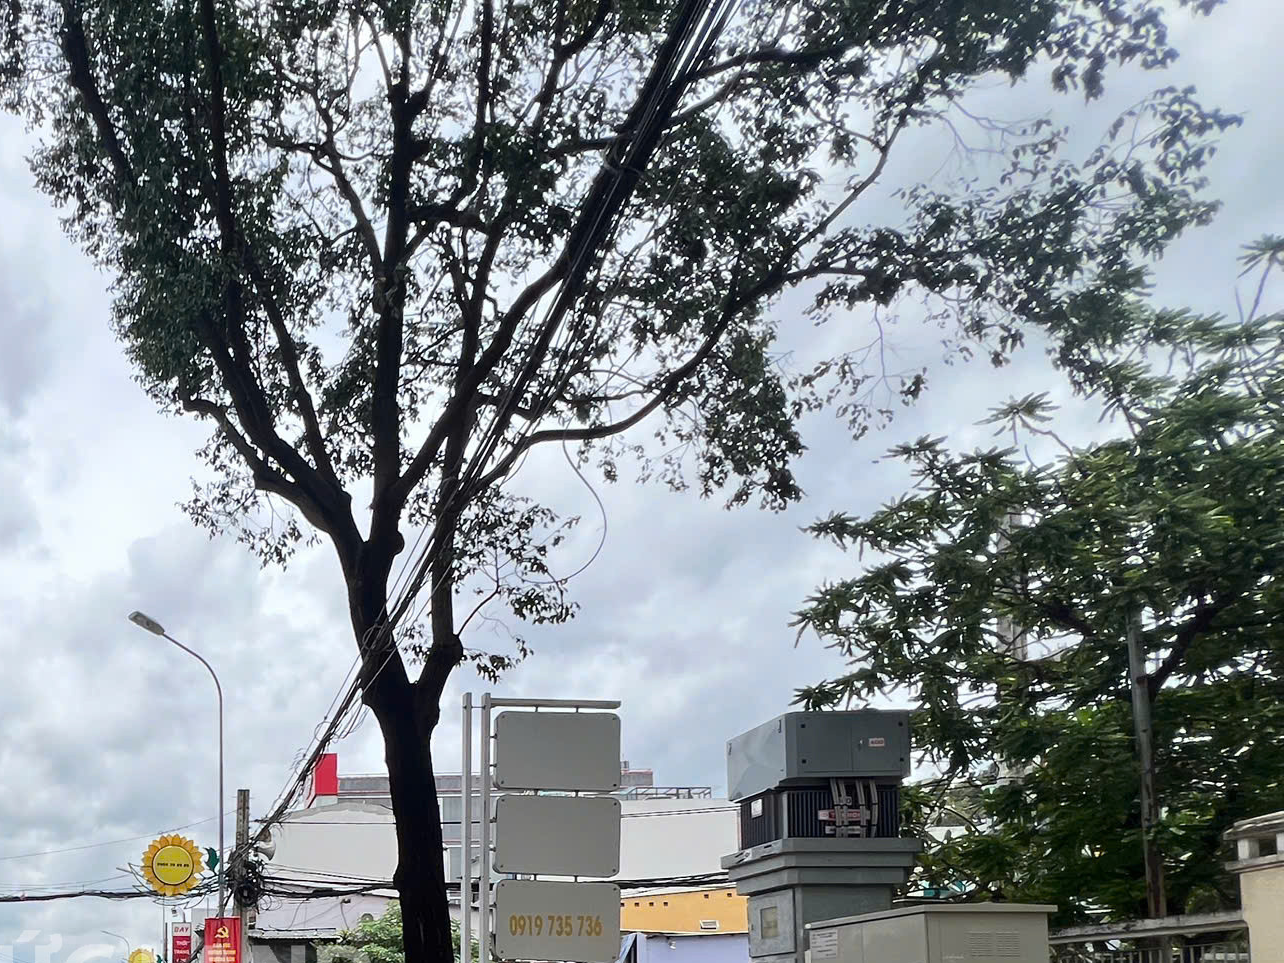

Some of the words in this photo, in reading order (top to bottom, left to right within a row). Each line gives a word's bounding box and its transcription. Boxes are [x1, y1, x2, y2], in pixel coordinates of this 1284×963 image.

[509, 915, 543, 936] 0919
[547, 915, 573, 936] 735
[577, 915, 602, 936] 736
